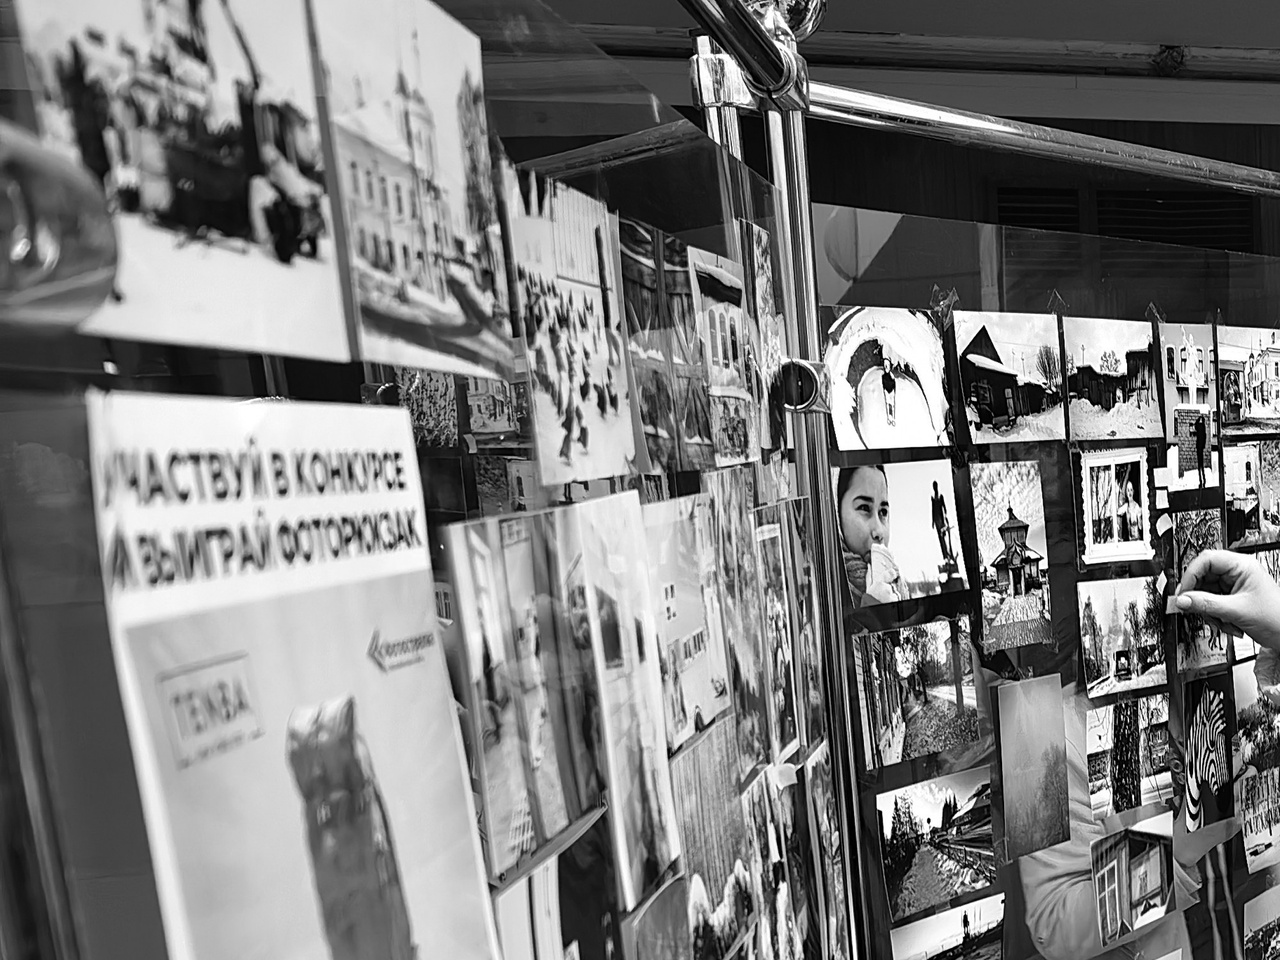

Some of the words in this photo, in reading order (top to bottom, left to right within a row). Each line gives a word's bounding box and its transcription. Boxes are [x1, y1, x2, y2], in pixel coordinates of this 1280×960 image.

[270, 451, 289, 498] В
[294, 451, 406, 494] КОНКУРСЕ
[138, 508, 271, 585] ВЫИГРАЙ
[277, 508, 421, 566] ФОТОРЮКЗАК
